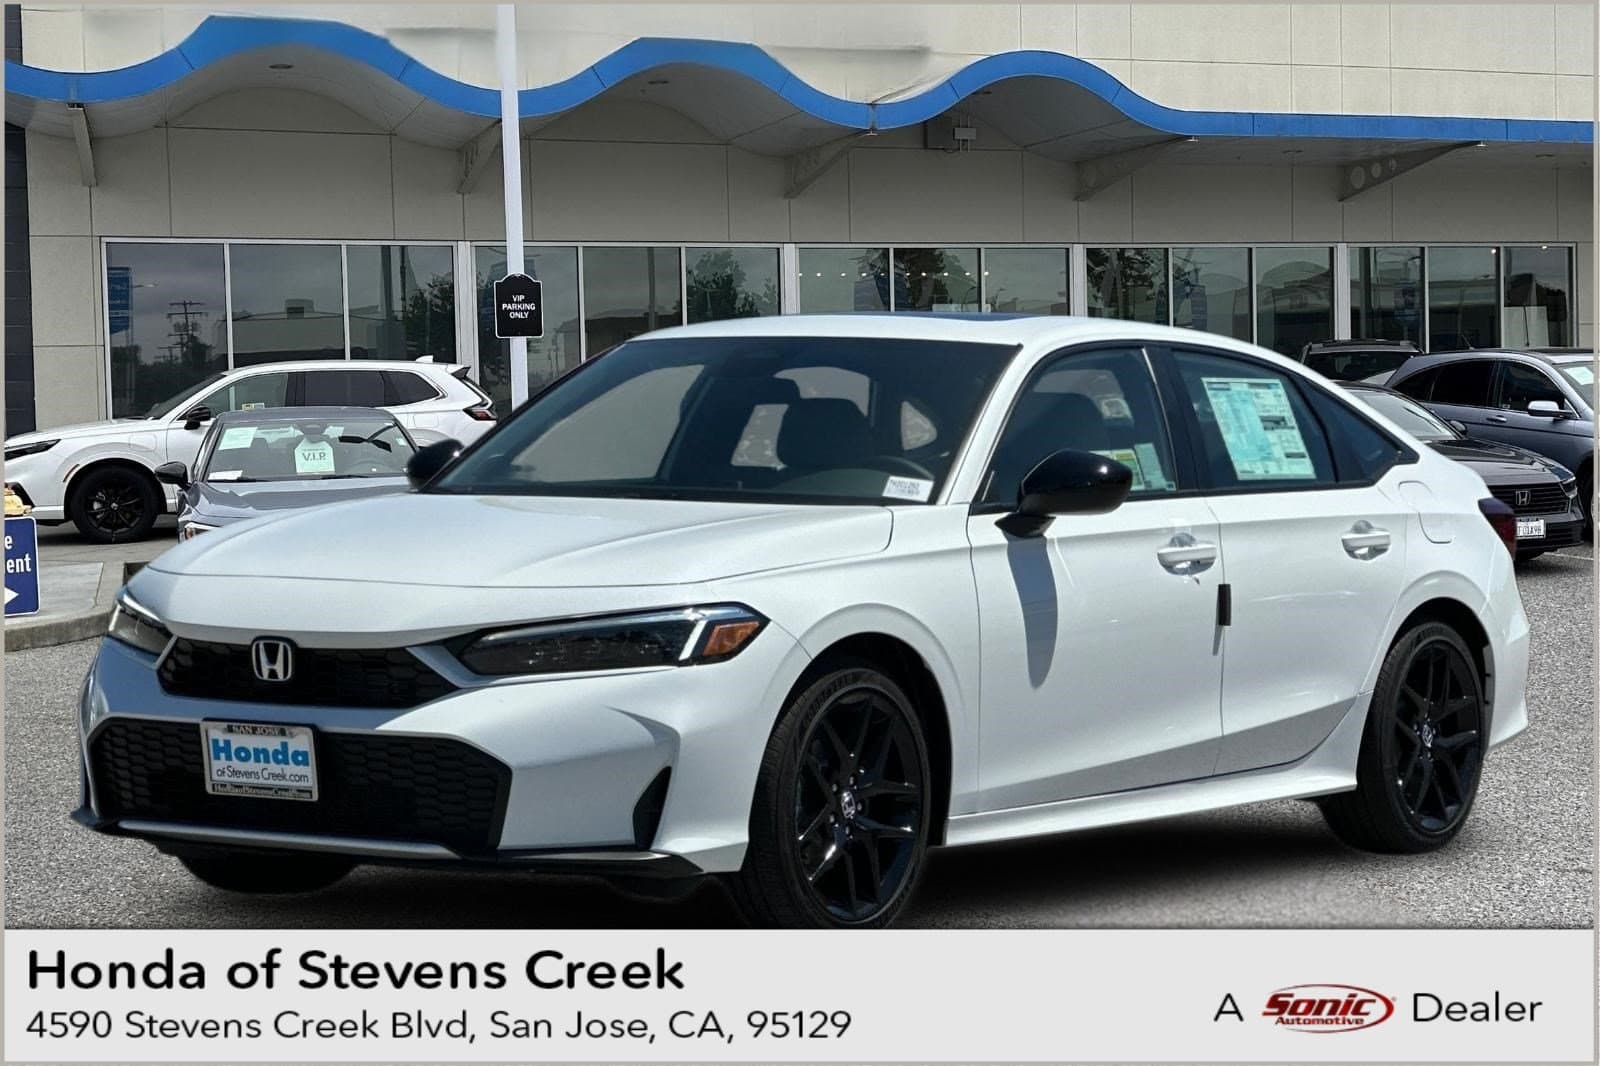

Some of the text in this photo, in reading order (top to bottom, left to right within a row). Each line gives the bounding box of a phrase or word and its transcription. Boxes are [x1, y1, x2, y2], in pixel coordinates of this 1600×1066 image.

[512, 294, 525, 302] VIP
[502, 303, 536, 311] PARKING
[509, 311, 529, 319] ONLY
[211, 738, 310, 767] Honda
[216, 765, 309, 783] of Stevens Creek.com
